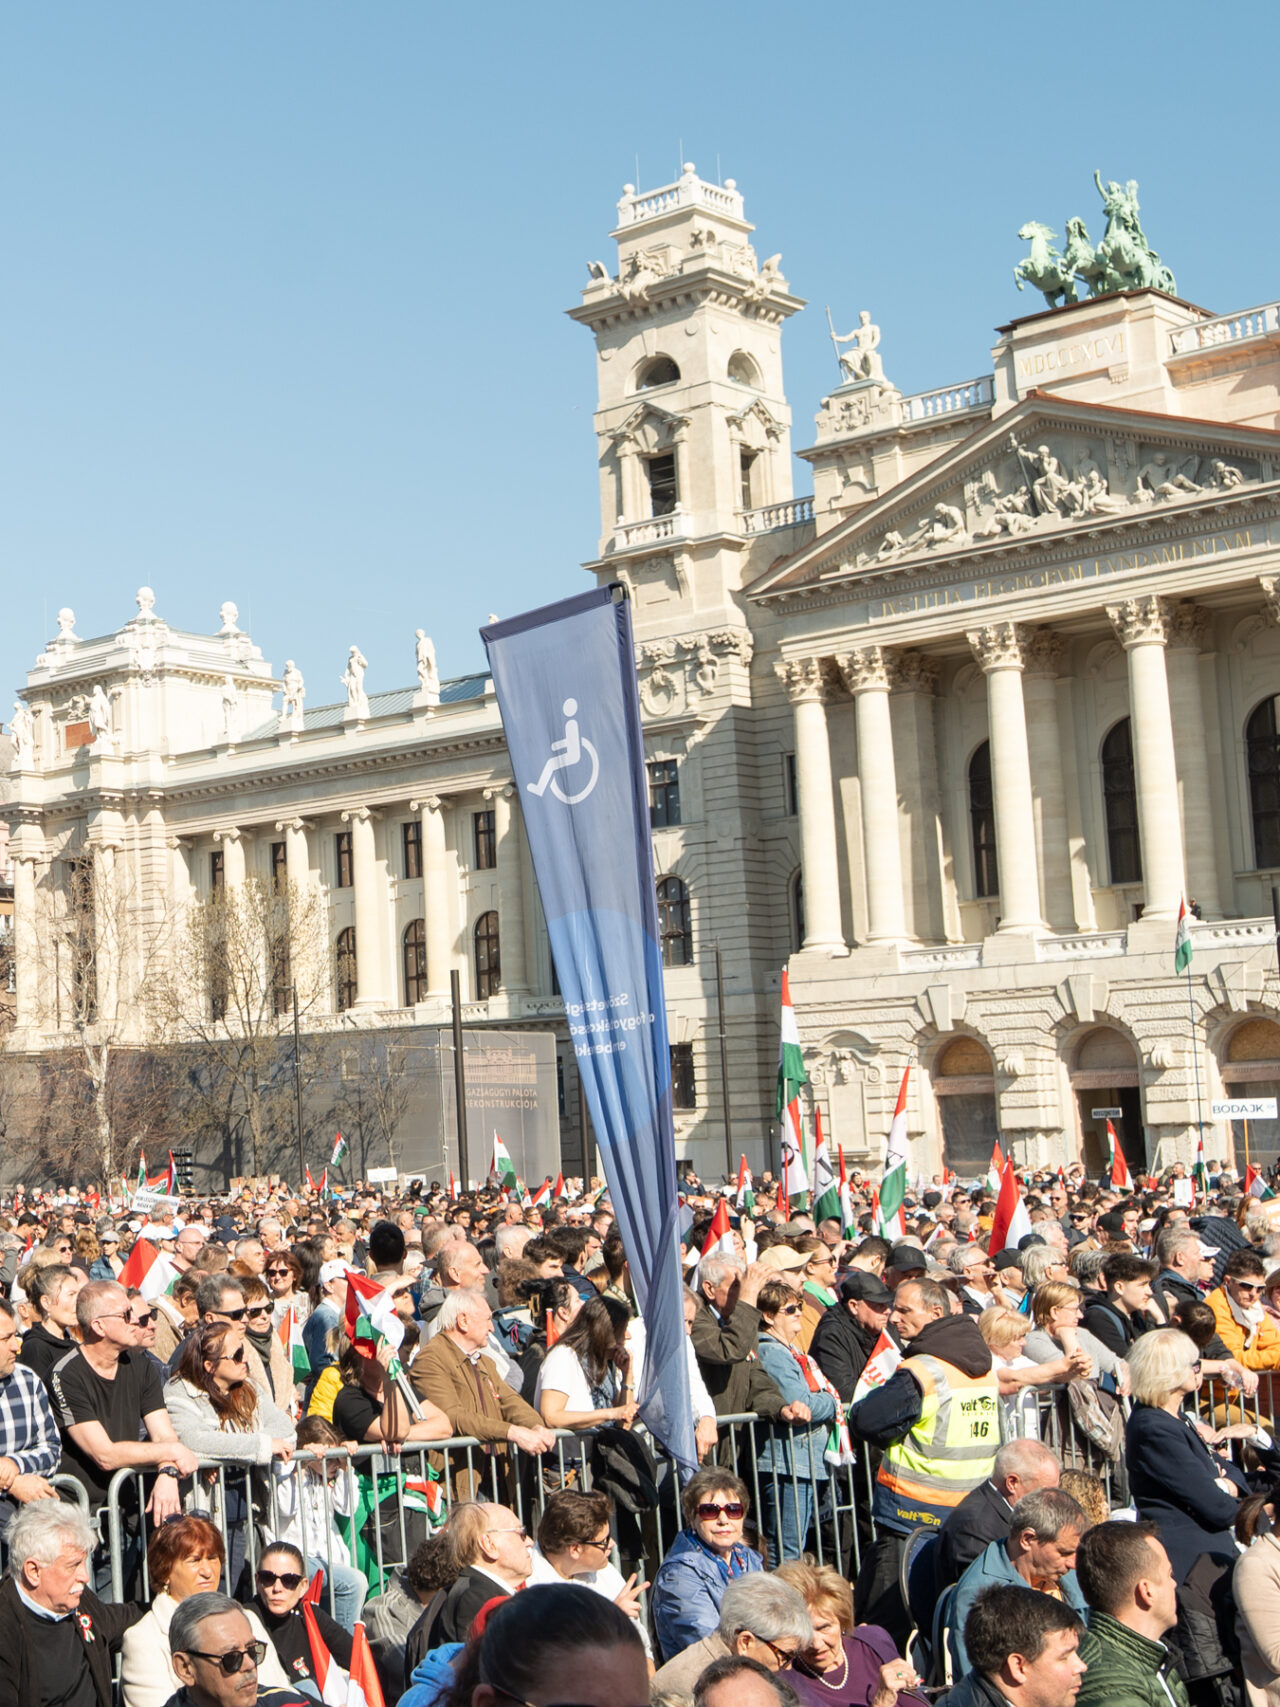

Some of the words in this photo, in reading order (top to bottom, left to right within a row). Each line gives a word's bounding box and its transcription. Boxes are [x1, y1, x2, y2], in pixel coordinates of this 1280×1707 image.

[1020, 333, 1124, 377] MDCCCXCVI
[881, 589, 964, 618] IVSTITIA
[1095, 530, 1253, 577] FVNDAMENTVM
[512, 1087, 537, 1097] PALOTA
[1212, 1104, 1264, 1114] BODAJK
[970, 1421, 990, 1438] 146
